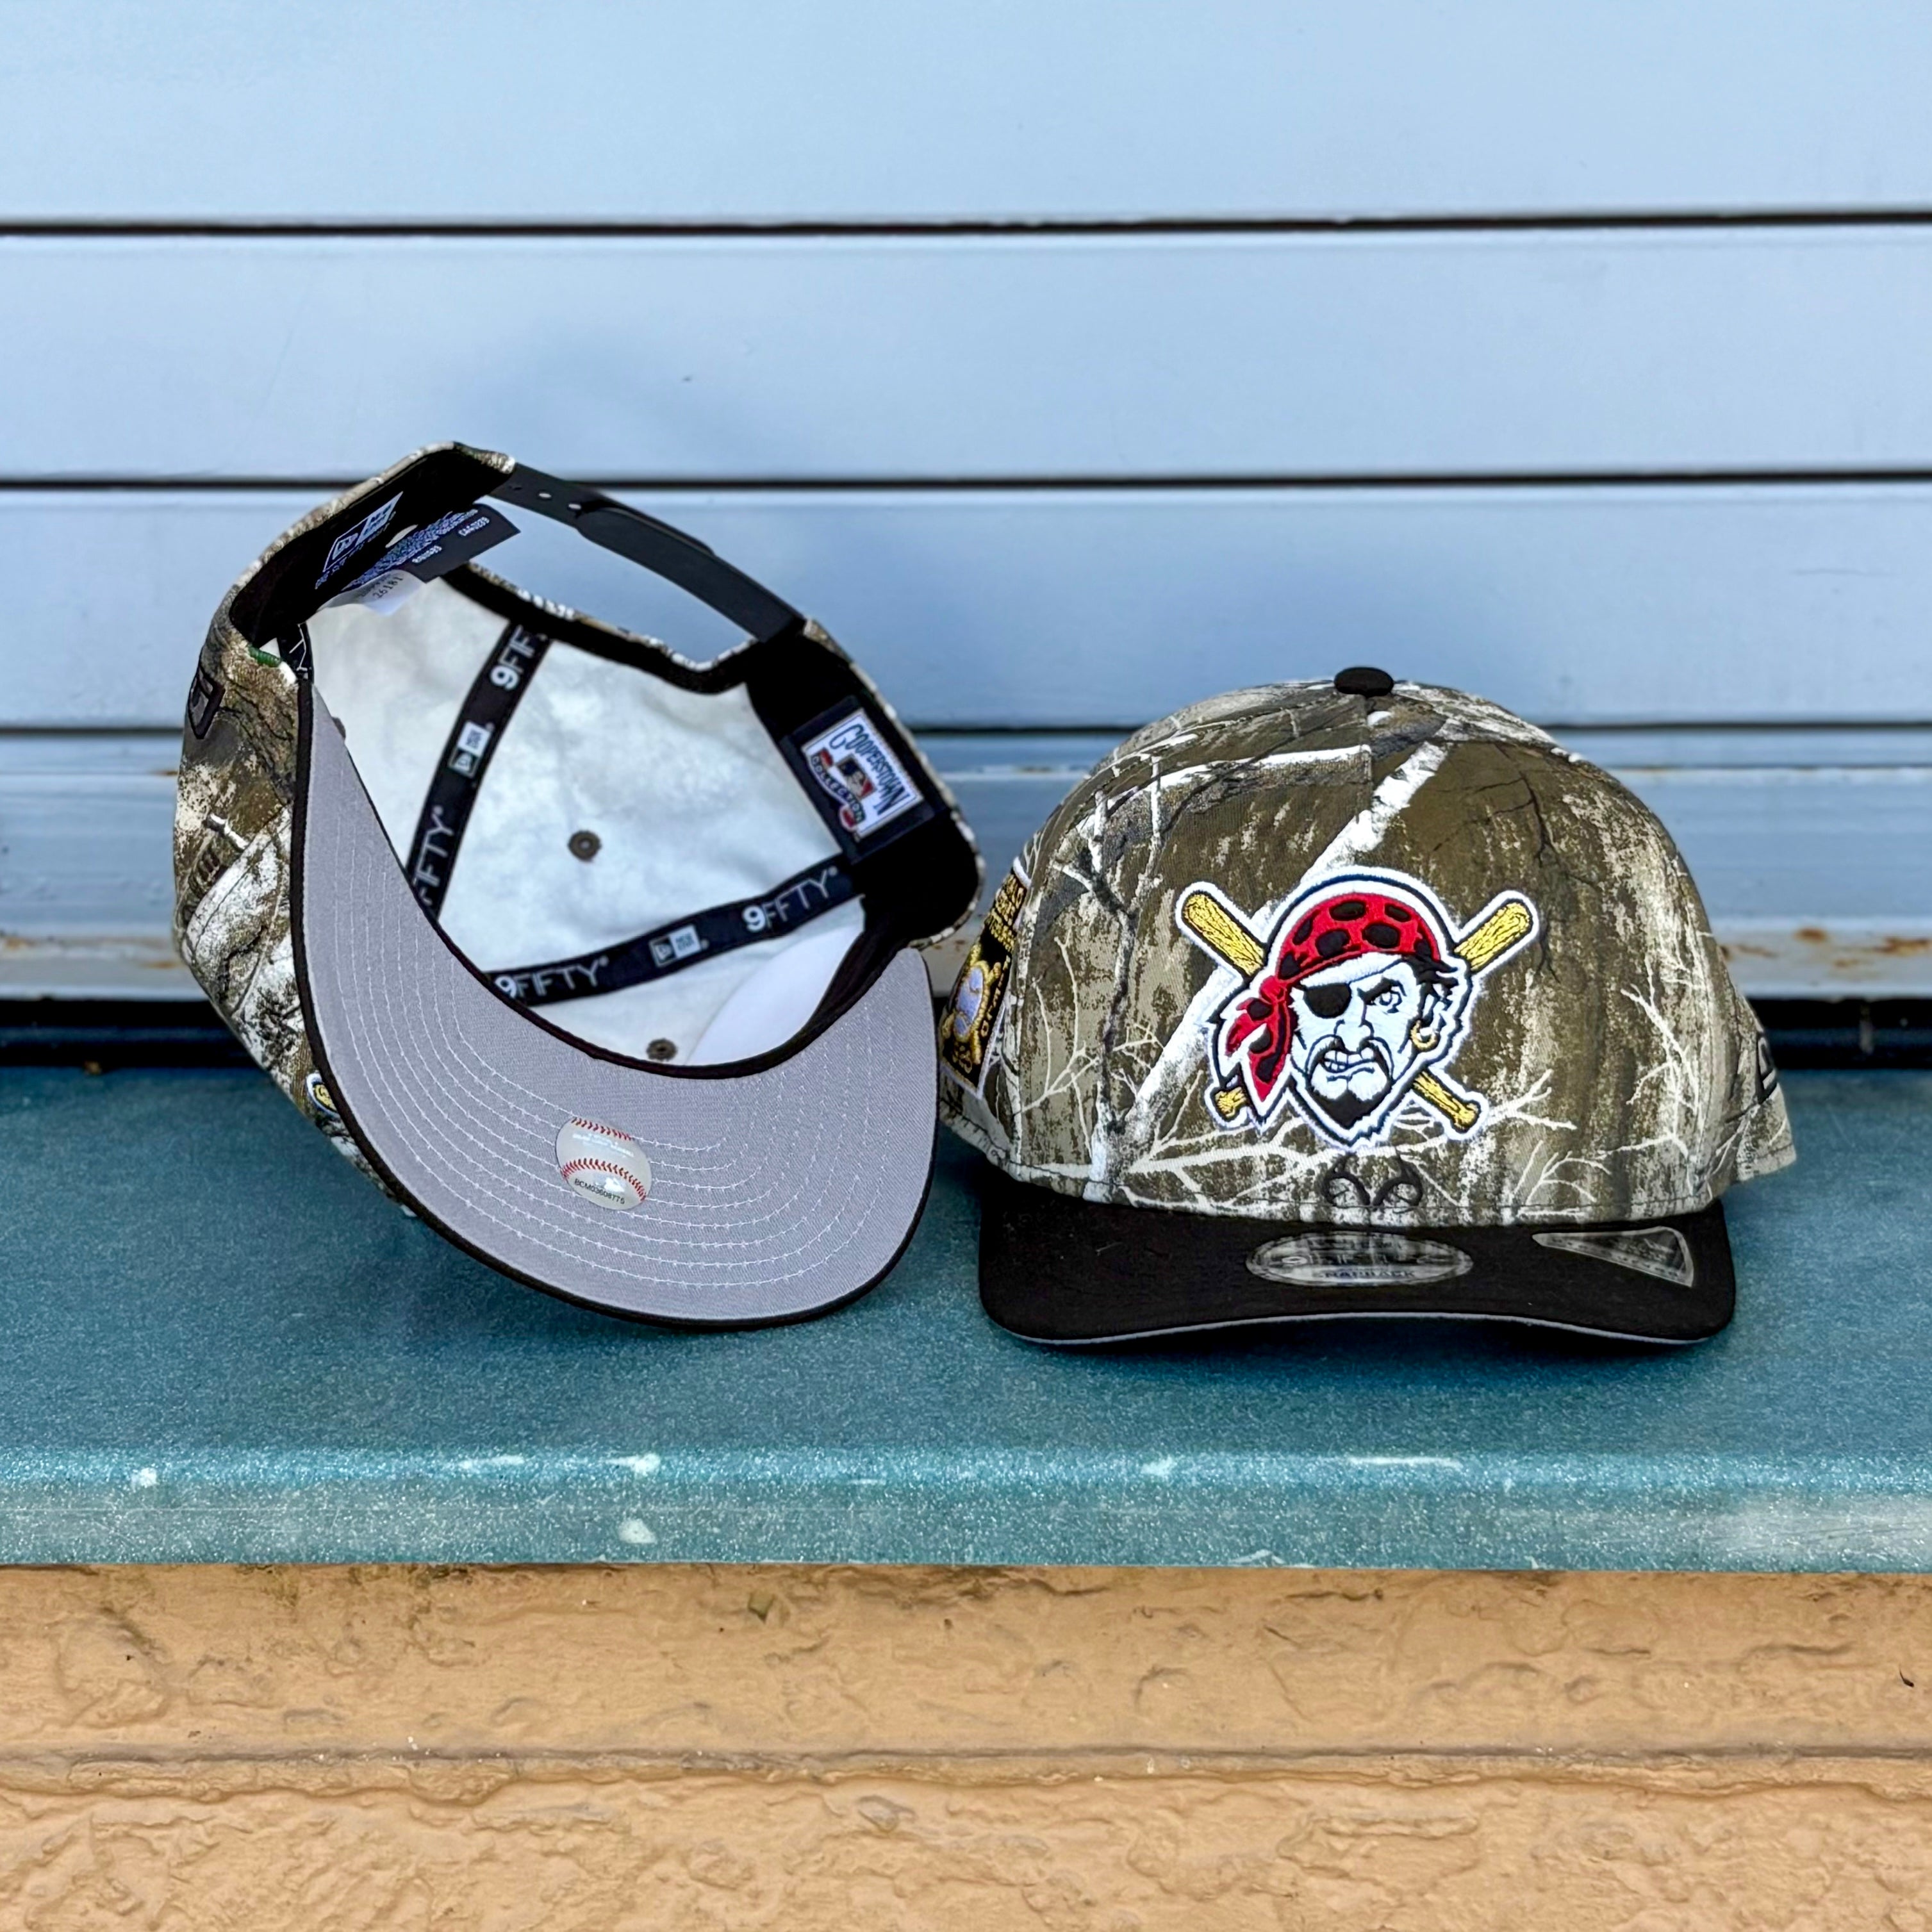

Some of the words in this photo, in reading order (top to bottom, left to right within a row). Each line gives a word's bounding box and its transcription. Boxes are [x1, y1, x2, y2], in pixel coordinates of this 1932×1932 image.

[489, 624, 536, 691] 9FIF
[811, 755, 865, 822] COLLECTION
[829, 723, 911, 816] COOPERSTOWN
